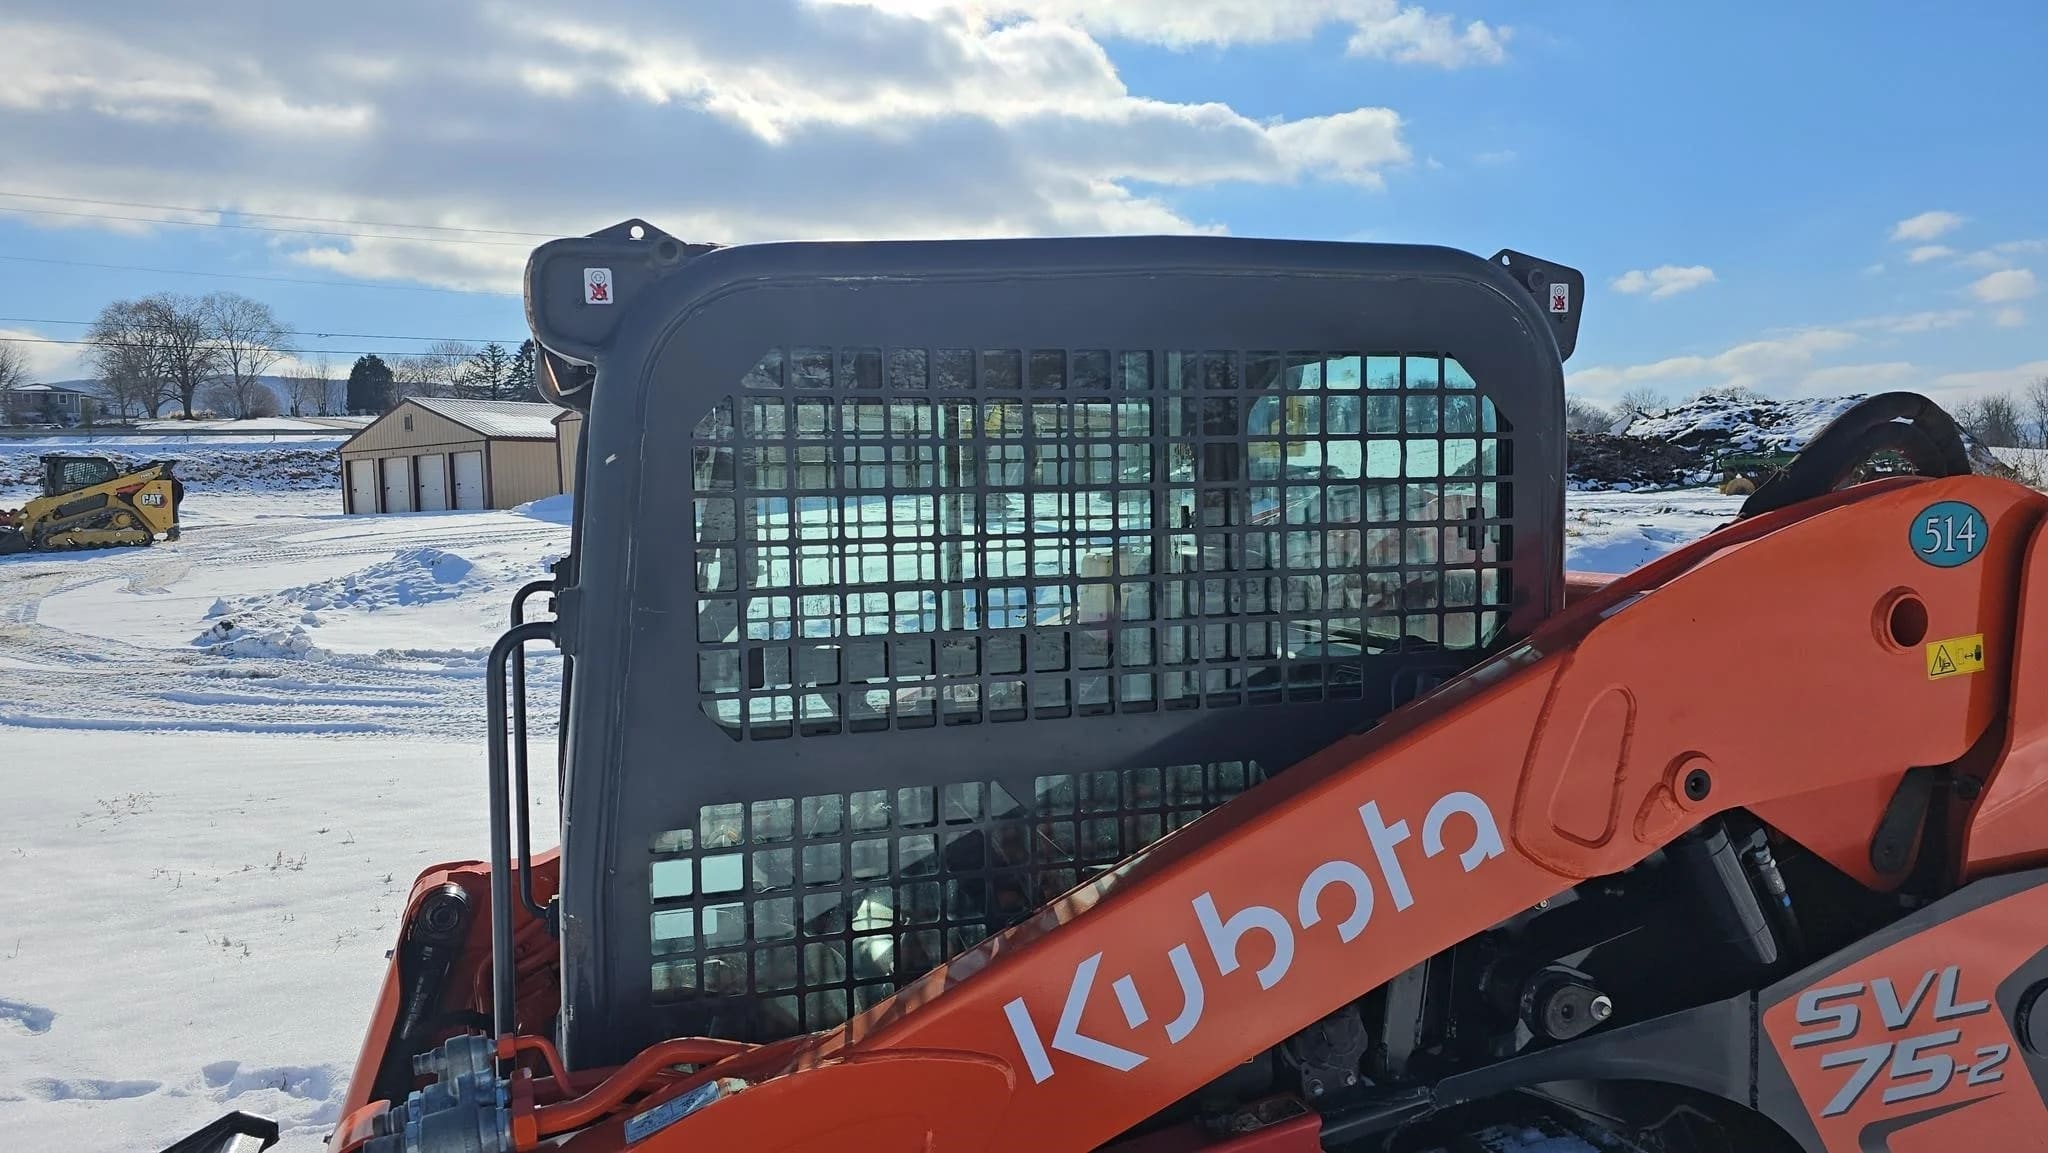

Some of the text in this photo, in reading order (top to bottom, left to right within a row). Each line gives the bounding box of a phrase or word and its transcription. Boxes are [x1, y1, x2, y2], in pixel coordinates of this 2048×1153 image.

[141, 494, 161, 506] CAT
[1922, 514, 1976, 553] 514
[1003, 791, 1505, 1084] Kubota
[1791, 965, 1991, 1049] SVL
[1820, 1029, 2010, 1118] 75-2
